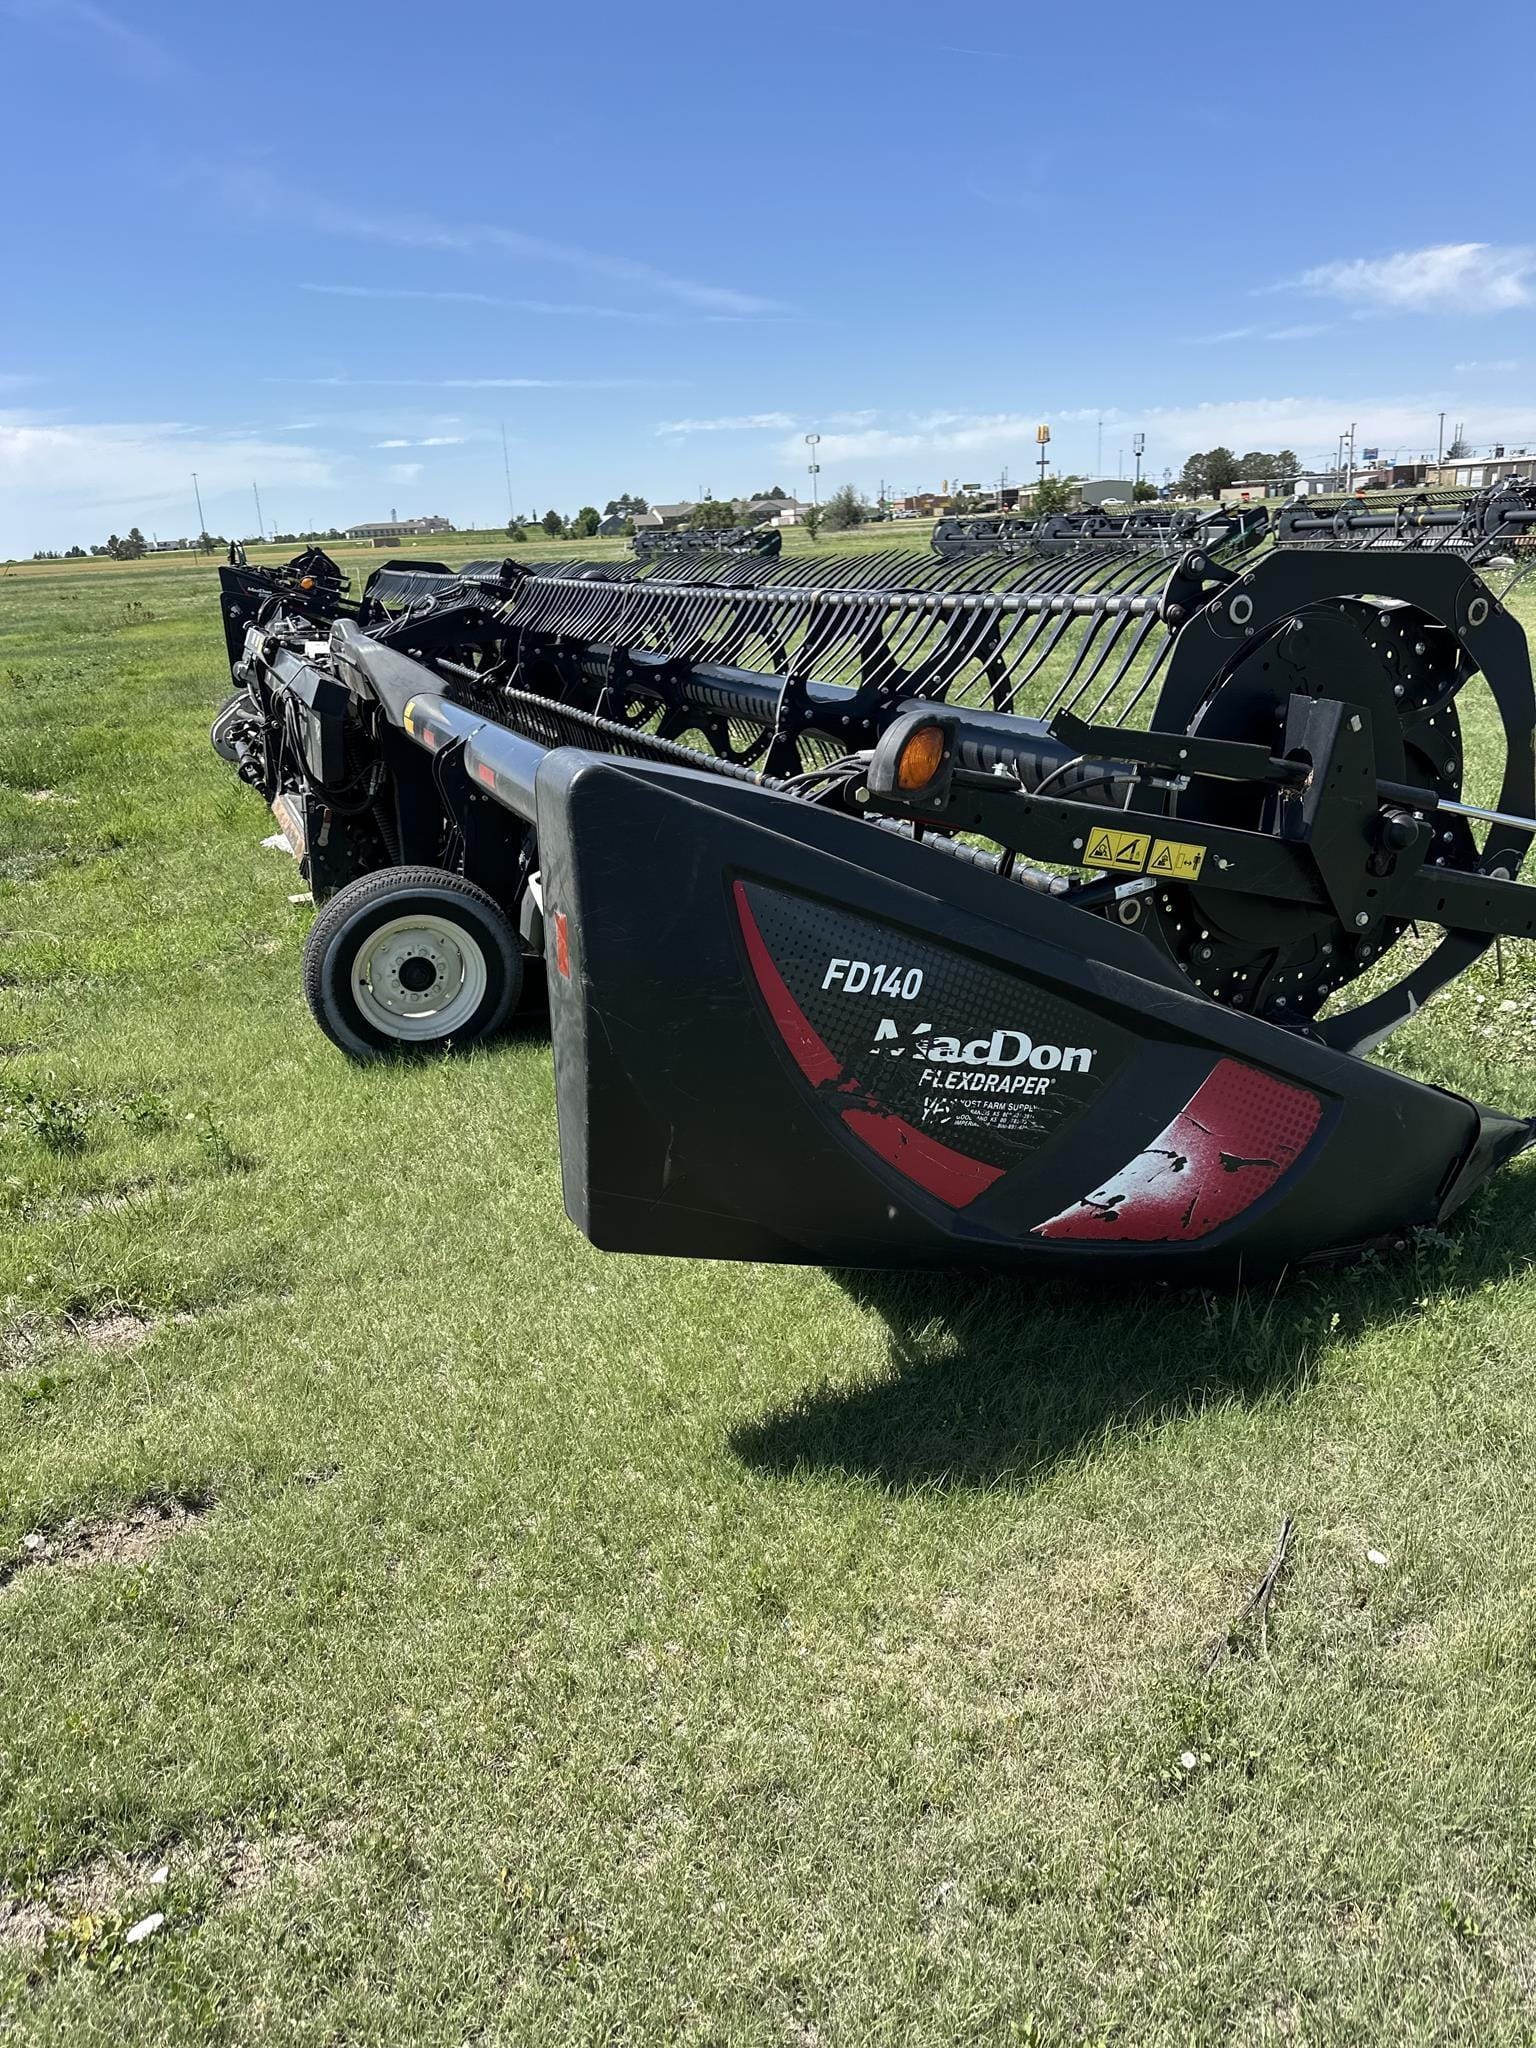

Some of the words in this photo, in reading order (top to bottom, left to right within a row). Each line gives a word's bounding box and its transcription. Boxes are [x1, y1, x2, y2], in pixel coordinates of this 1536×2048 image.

[821, 958, 924, 1000] FD140
[918, 1068, 1051, 1096] FLEXDRAPER
[982, 1100, 1007, 1111] FARM
